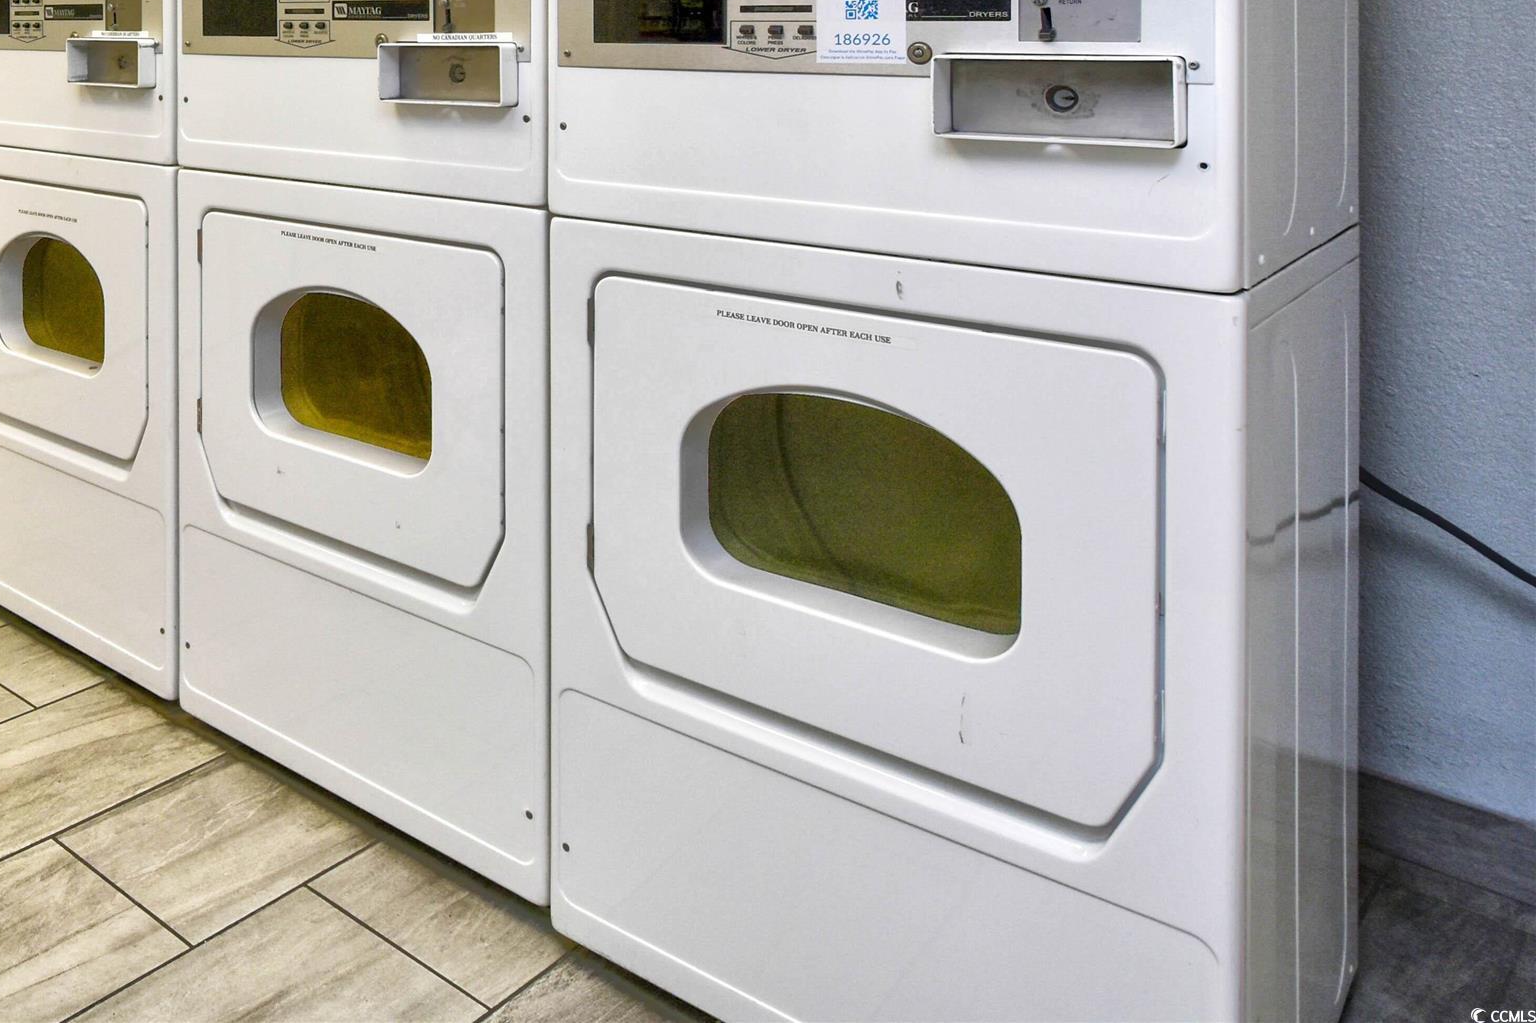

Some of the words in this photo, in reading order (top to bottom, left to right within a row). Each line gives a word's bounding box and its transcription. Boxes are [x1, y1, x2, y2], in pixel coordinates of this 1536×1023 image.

[348, 7, 382, 15] MAYTAG
[834, 33, 891, 46] 186926
[716, 309, 745, 321] PLEASE
[746, 314, 772, 325] LEAVE
[773, 319, 795, 329] DOOR
[797, 323, 818, 333] OPEN
[820, 327, 848, 337] AFTER
[849, 331, 873, 341] EACH
[874, 335, 892, 344] USE
